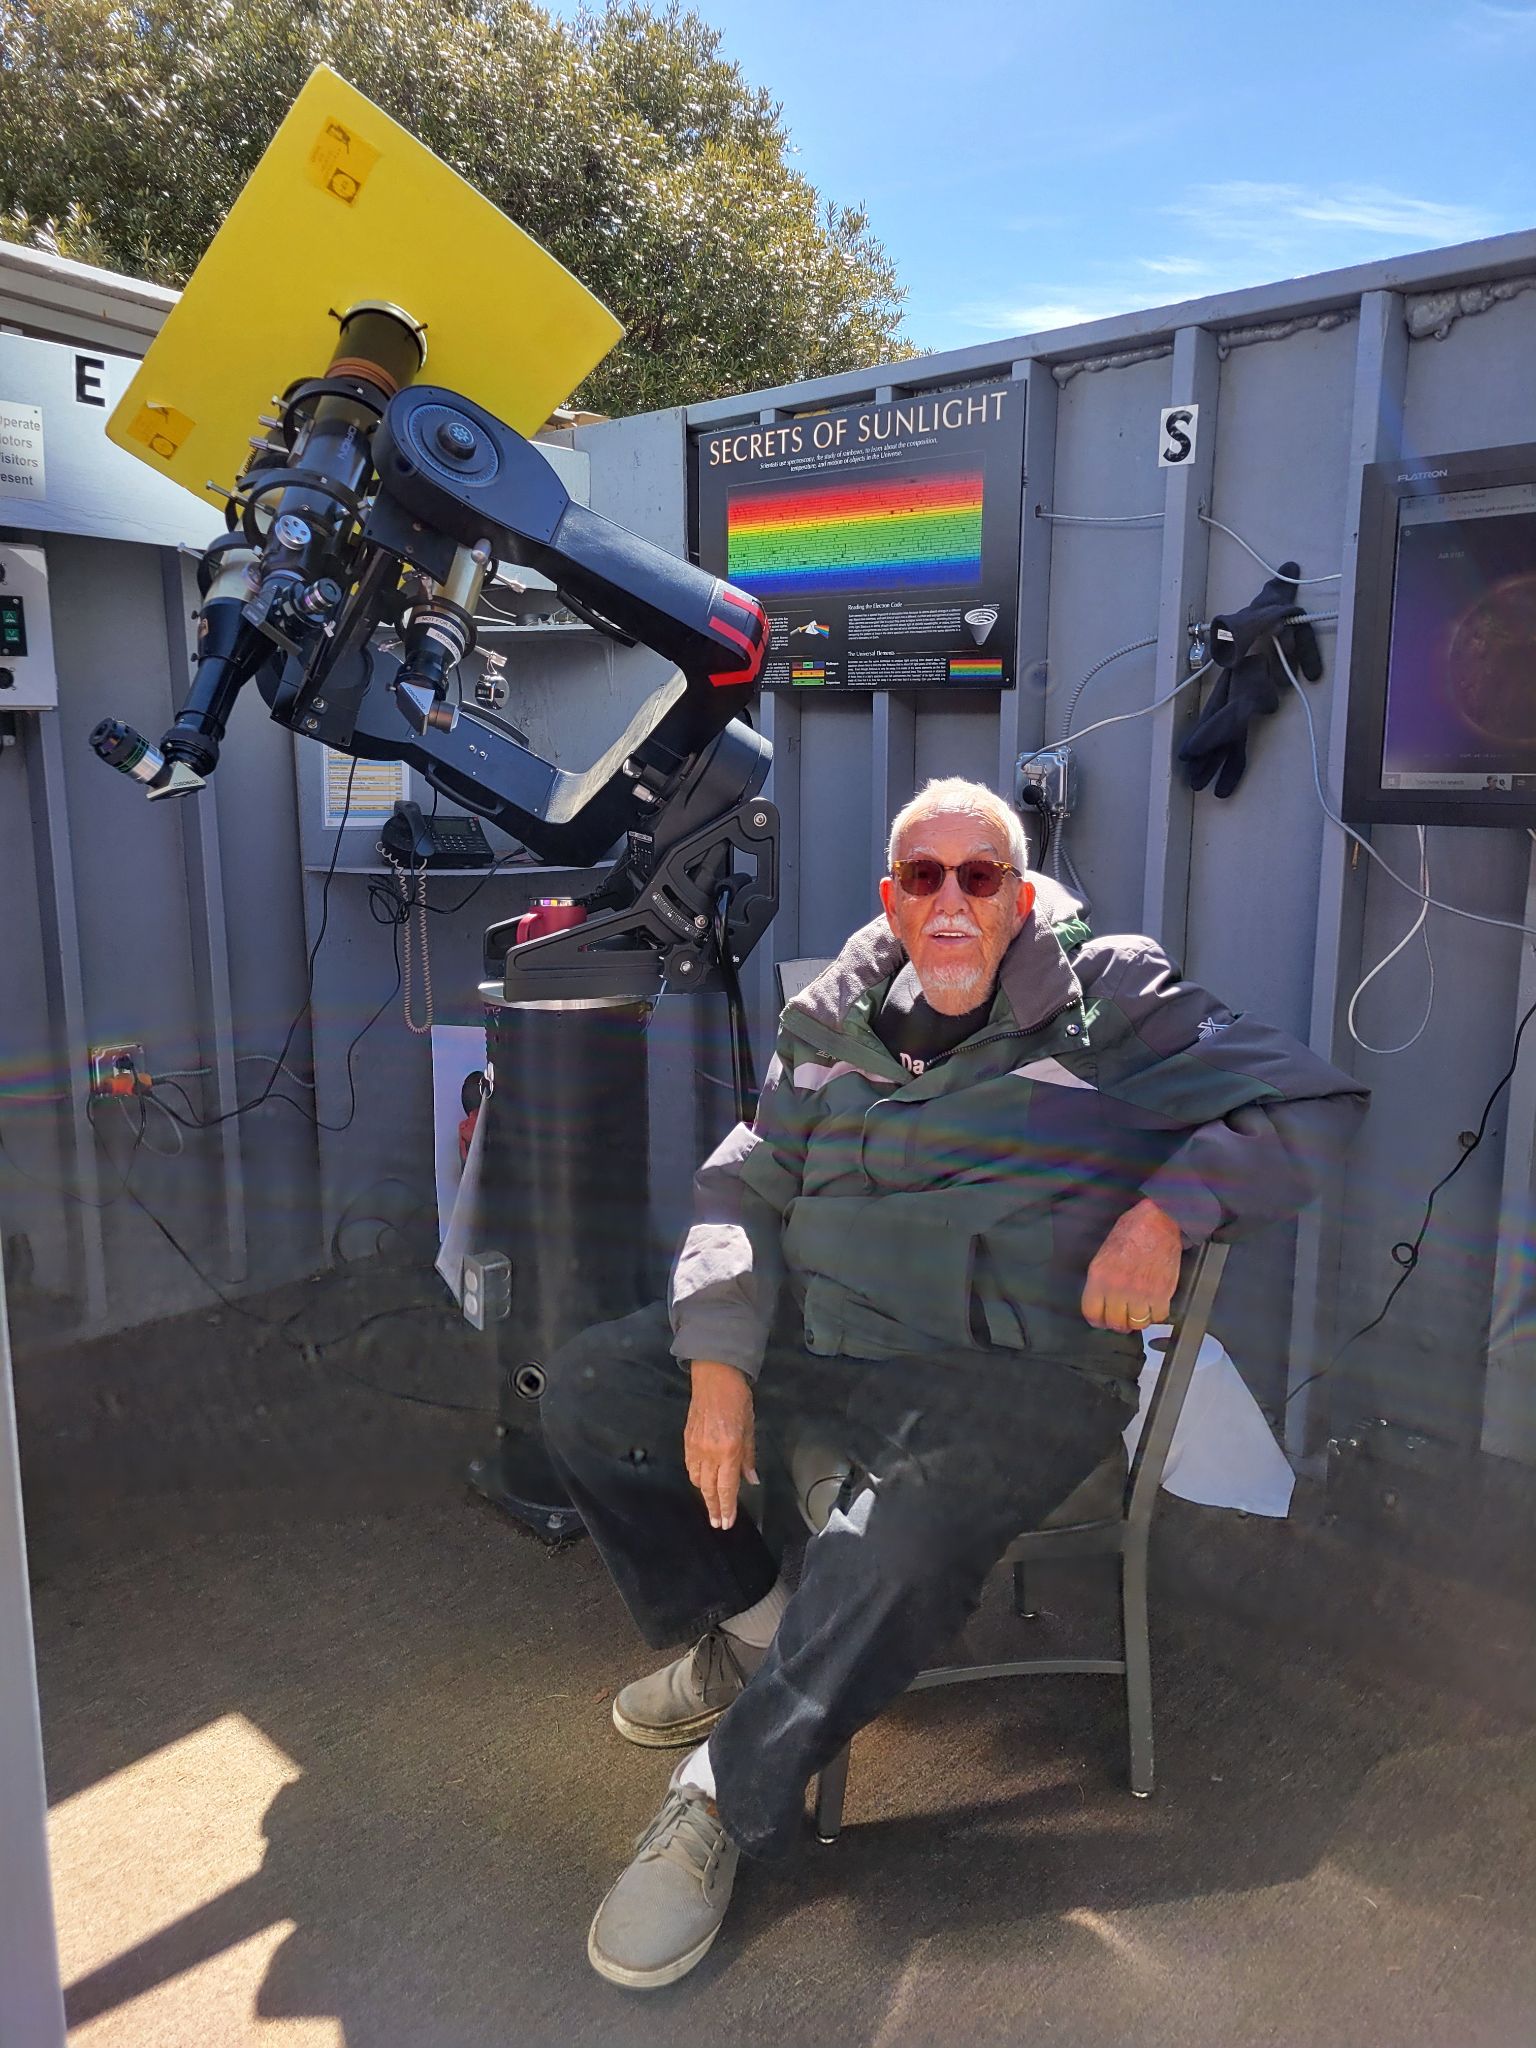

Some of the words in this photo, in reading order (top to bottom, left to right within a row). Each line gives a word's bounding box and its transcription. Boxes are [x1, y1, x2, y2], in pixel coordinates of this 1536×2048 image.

[75, 354, 105, 407] E
[710, 427, 803, 466] SECRETS
[813, 418, 848, 449] OF
[858, 391, 1008, 443] SUNLIGHT
[0, 433, 33, 449] otors
[1163, 410, 1193, 463] S
[884, 443, 897, 451] about
[0, 452, 39, 468] isitors
[0, 472, 34, 486] esent
[1397, 469, 1448, 482] FLATRON
[436, 618, 449, 626] FOR
[173, 779, 199, 787] CORONADO
